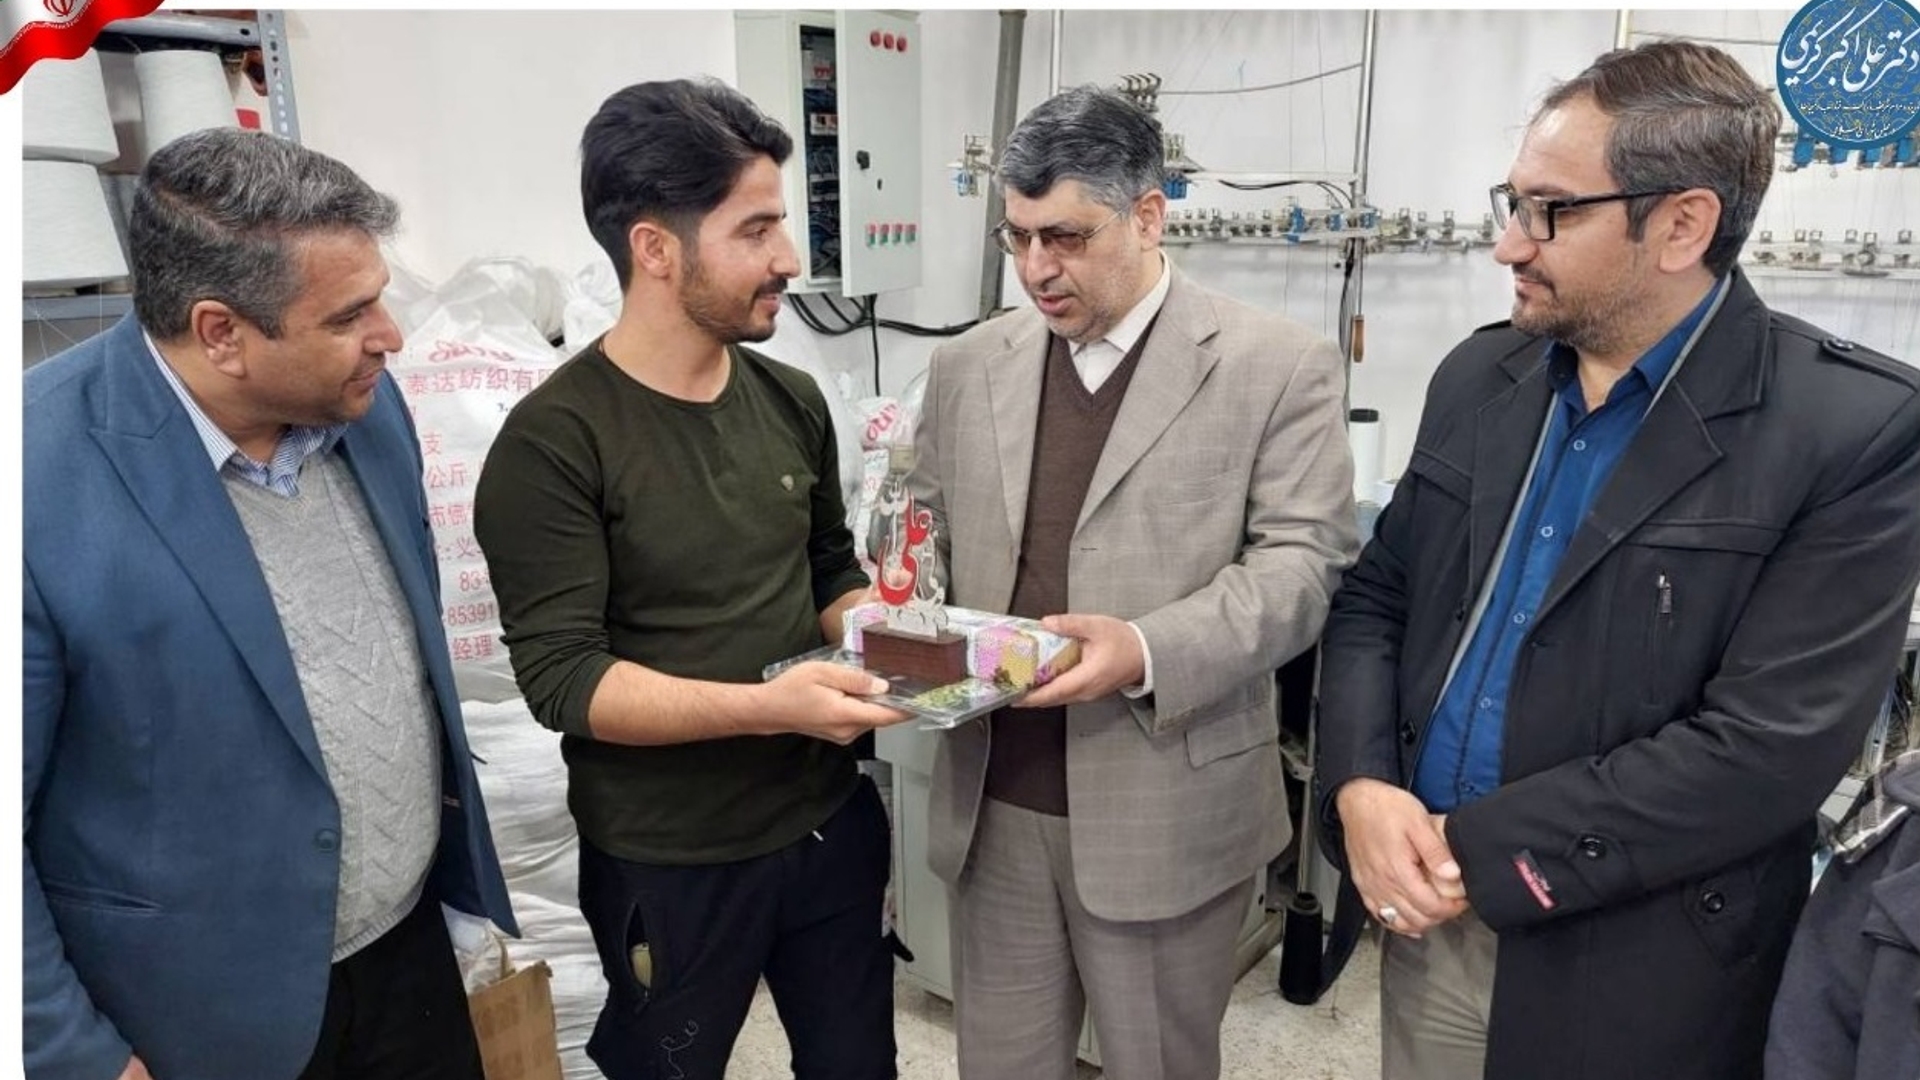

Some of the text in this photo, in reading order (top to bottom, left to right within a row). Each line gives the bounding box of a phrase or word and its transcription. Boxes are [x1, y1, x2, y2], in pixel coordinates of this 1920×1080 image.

[422, 431, 442, 456] 支
[427, 461, 467, 488] 公斤
[453, 633, 495, 661] 经理
